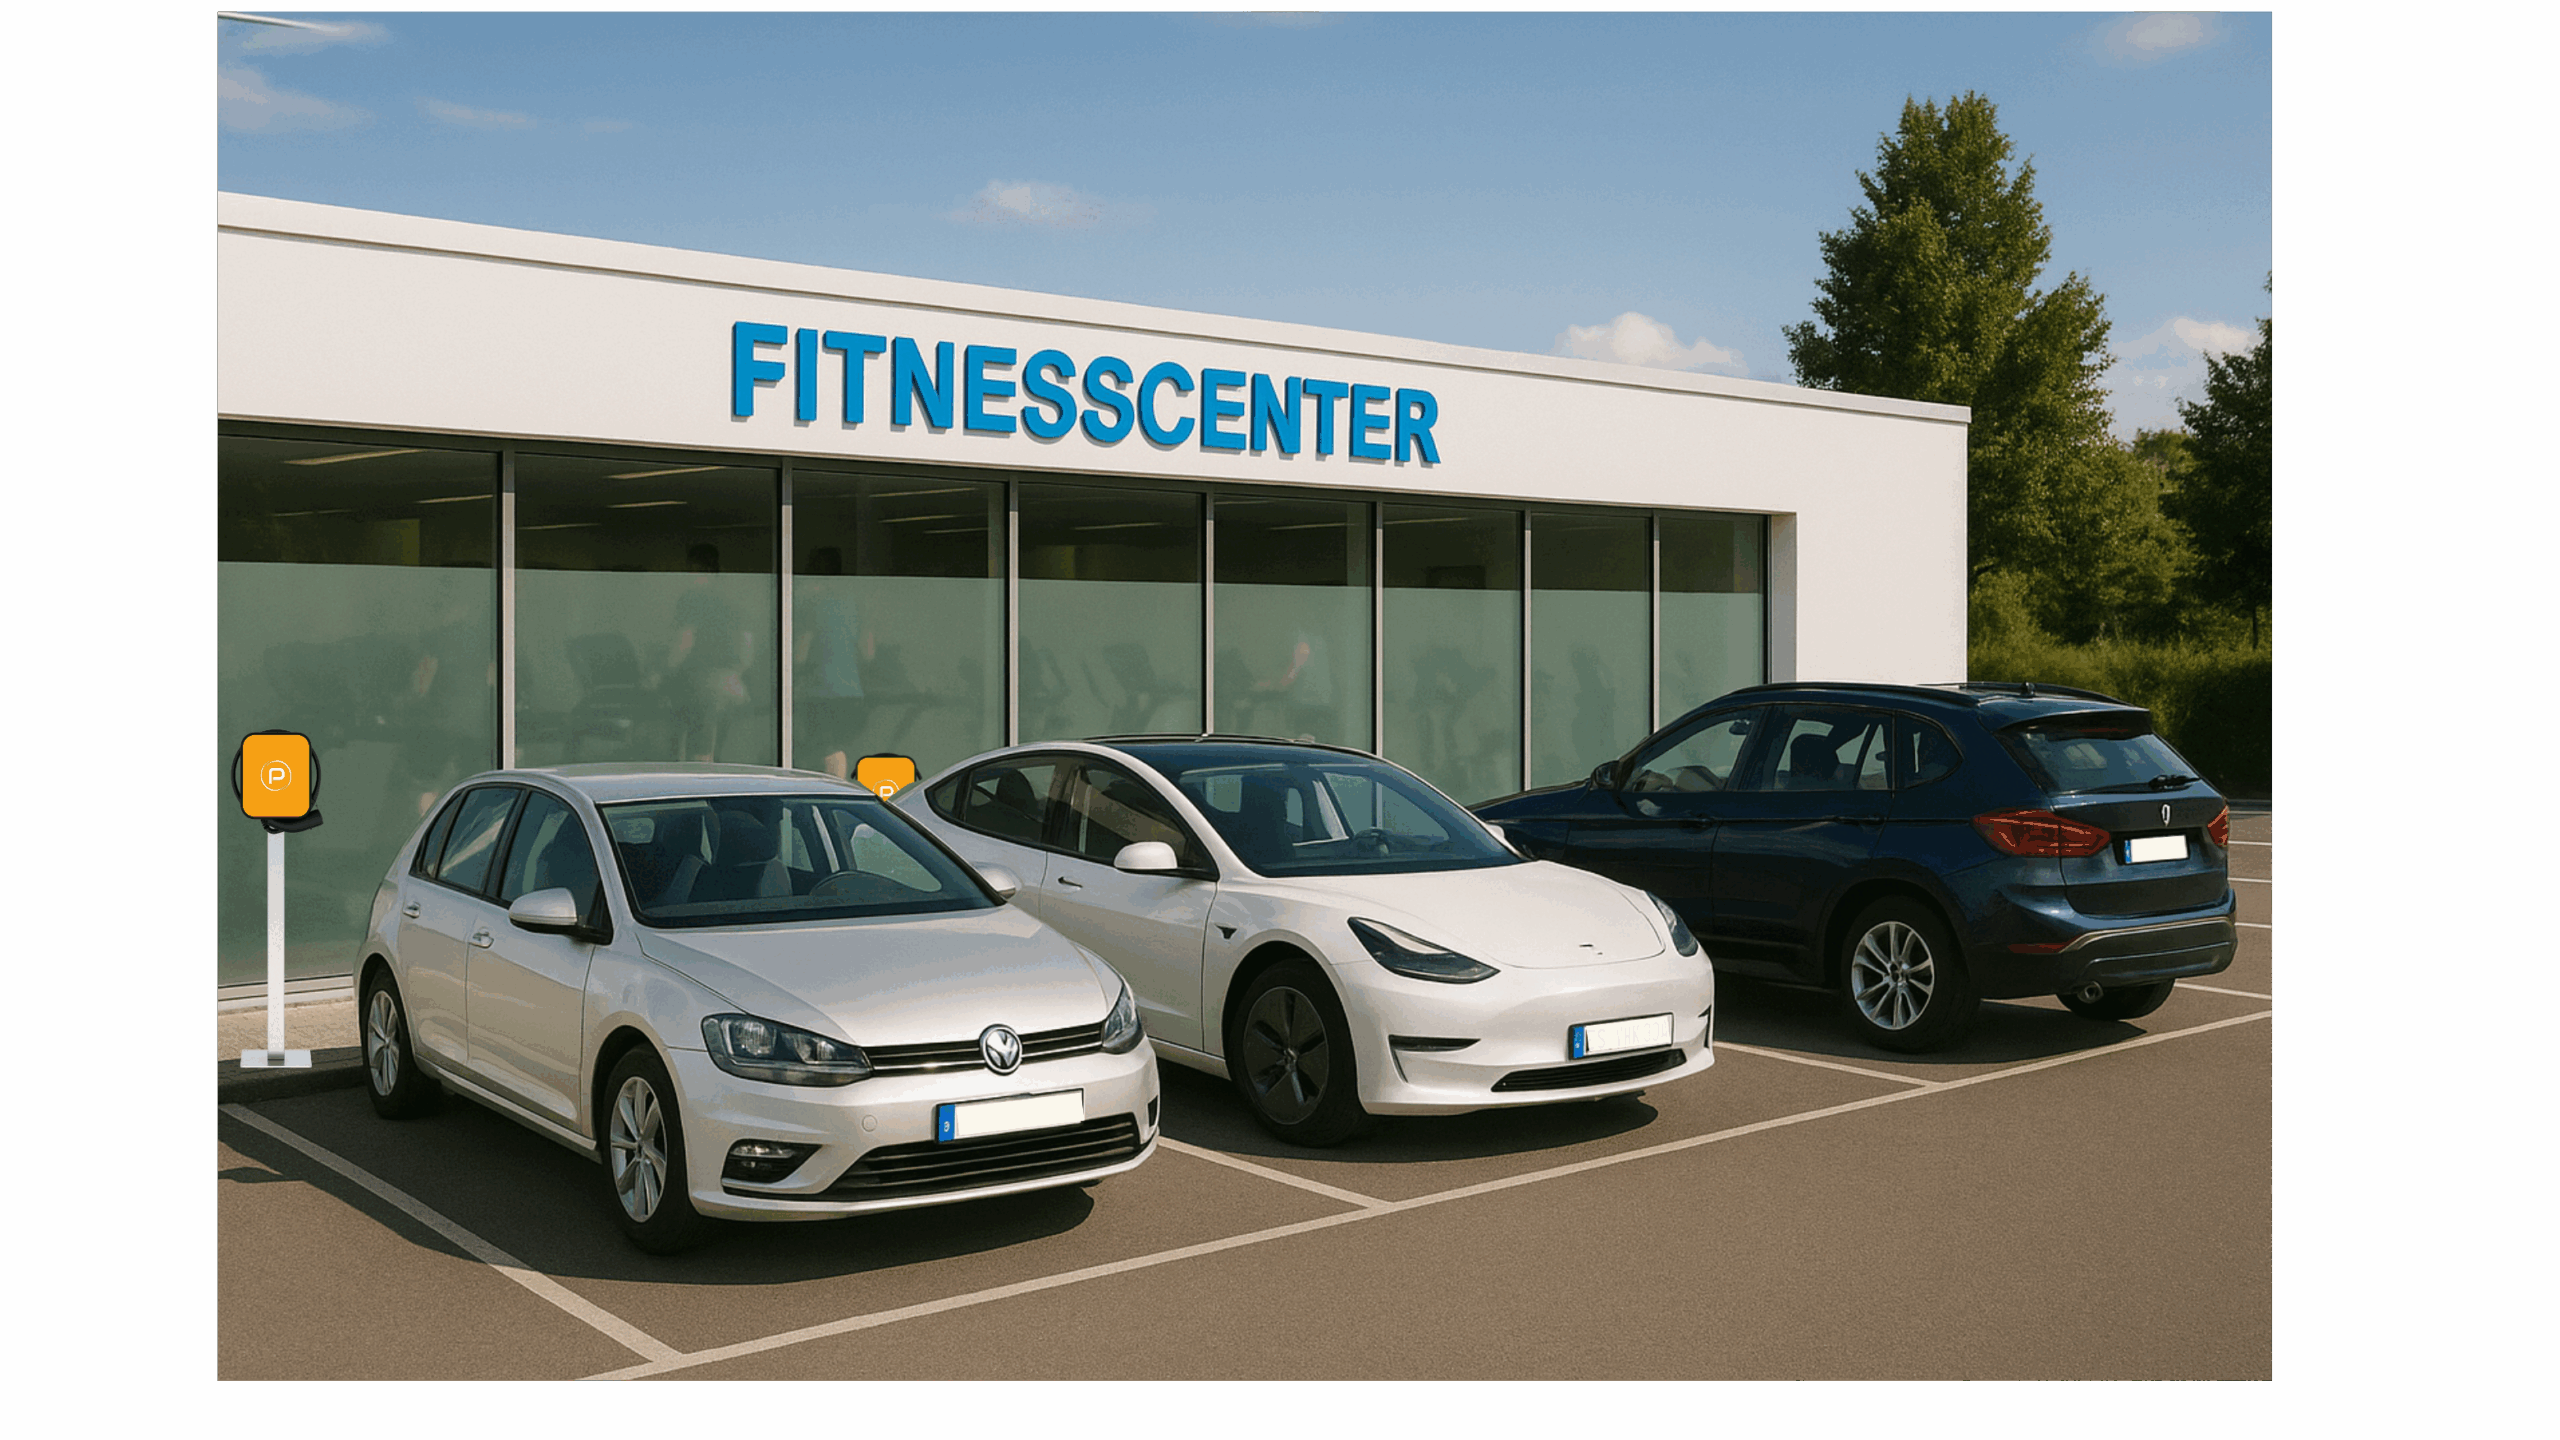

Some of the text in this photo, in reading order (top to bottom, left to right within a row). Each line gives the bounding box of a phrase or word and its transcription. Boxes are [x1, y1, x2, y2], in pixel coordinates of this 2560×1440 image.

[732, 321, 1441, 465] FITNESSCENTER
[268, 767, 286, 785] P
[880, 785, 895, 798] P
